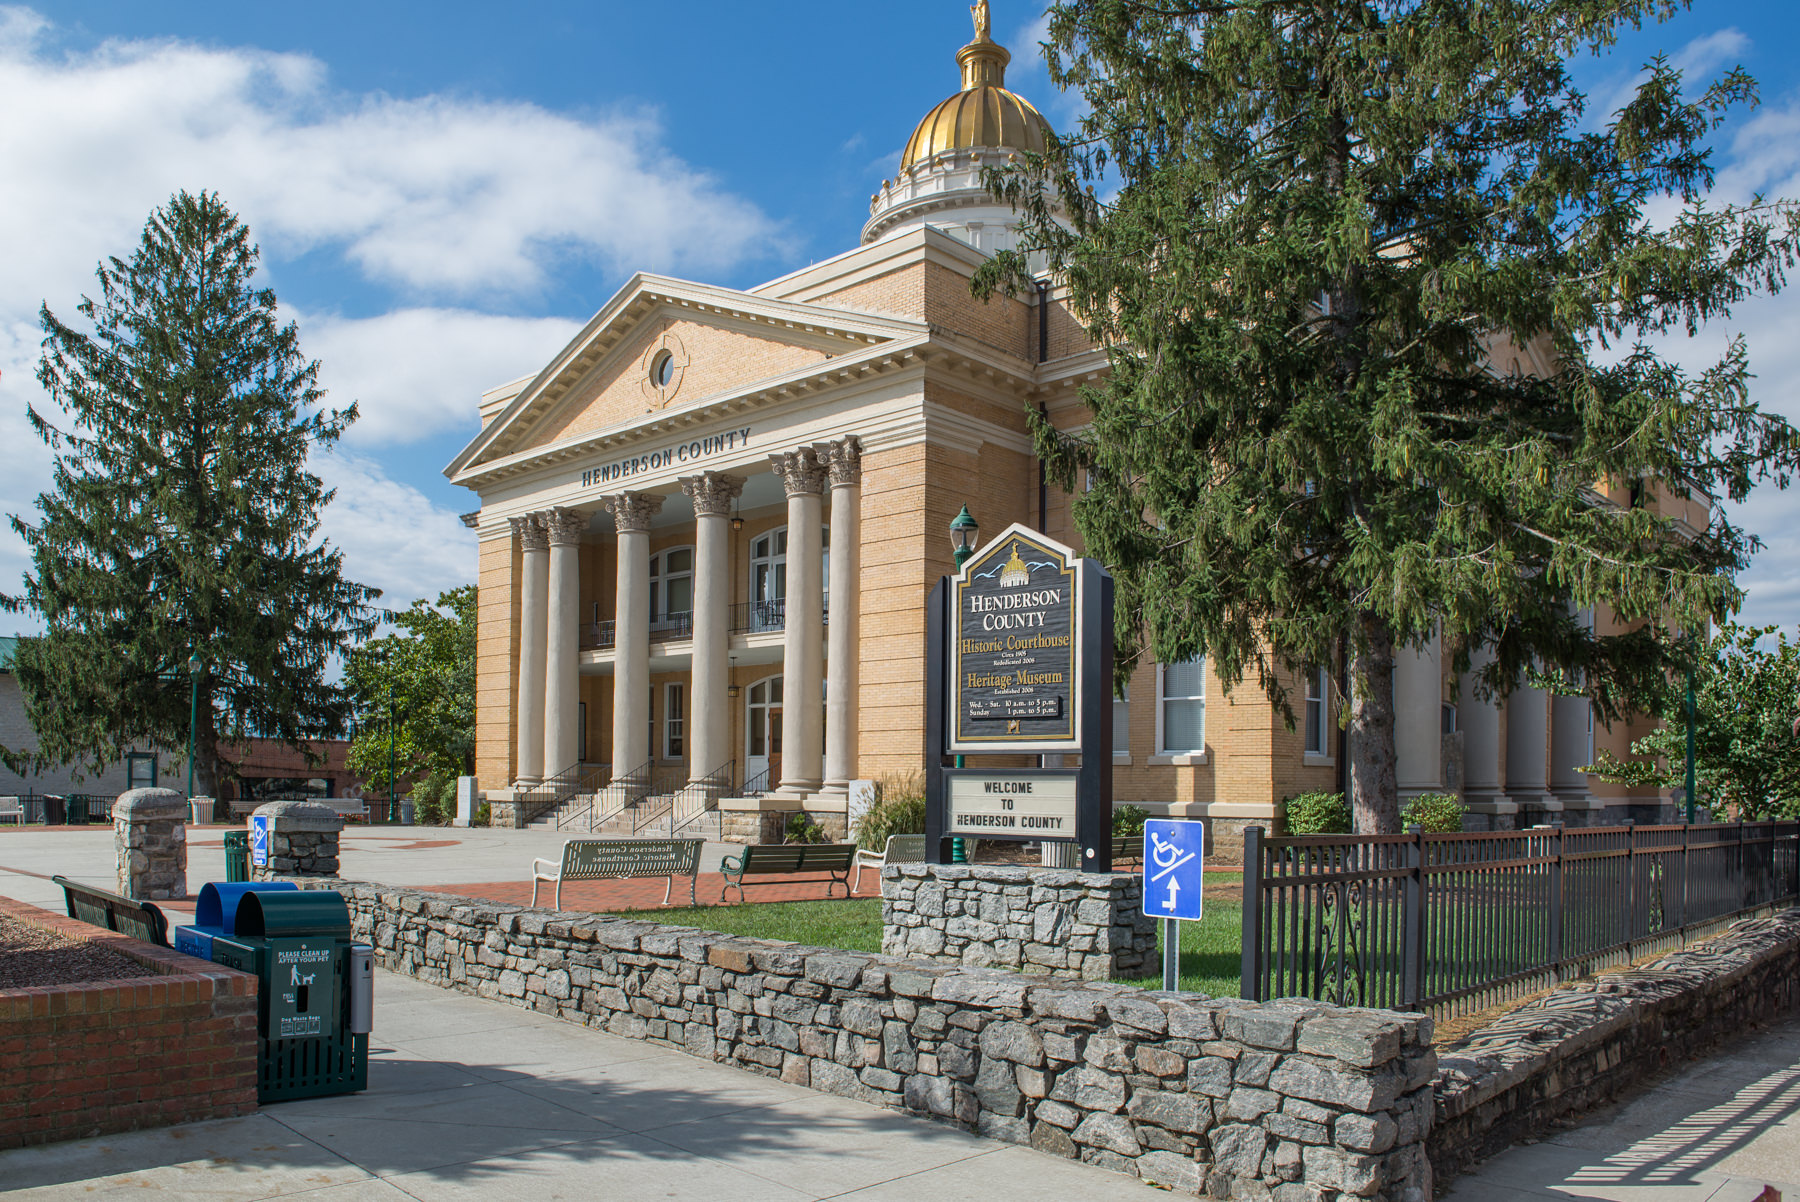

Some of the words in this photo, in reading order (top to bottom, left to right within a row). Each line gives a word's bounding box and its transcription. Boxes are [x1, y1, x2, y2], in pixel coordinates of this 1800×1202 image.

[581, 448, 673, 488] HENDERSON
[677, 427, 751, 462] COUNTY
[971, 589, 1061, 613] HENDERSON
[983, 611, 1047, 631] COUNTY
[962, 636, 1003, 653] Historic
[1007, 633, 1069, 650] Courthouse
[967, 672, 1012, 690] Heritage
[1016, 669, 1063, 685] Museum
[989, 700, 1001, 708] Sat.
[984, 782, 1032, 794] WELCOME
[1001, 799, 1014, 810] TO
[957, 814, 1015, 827] HENDERSON
[1021, 816, 1062, 828] COUNTY
